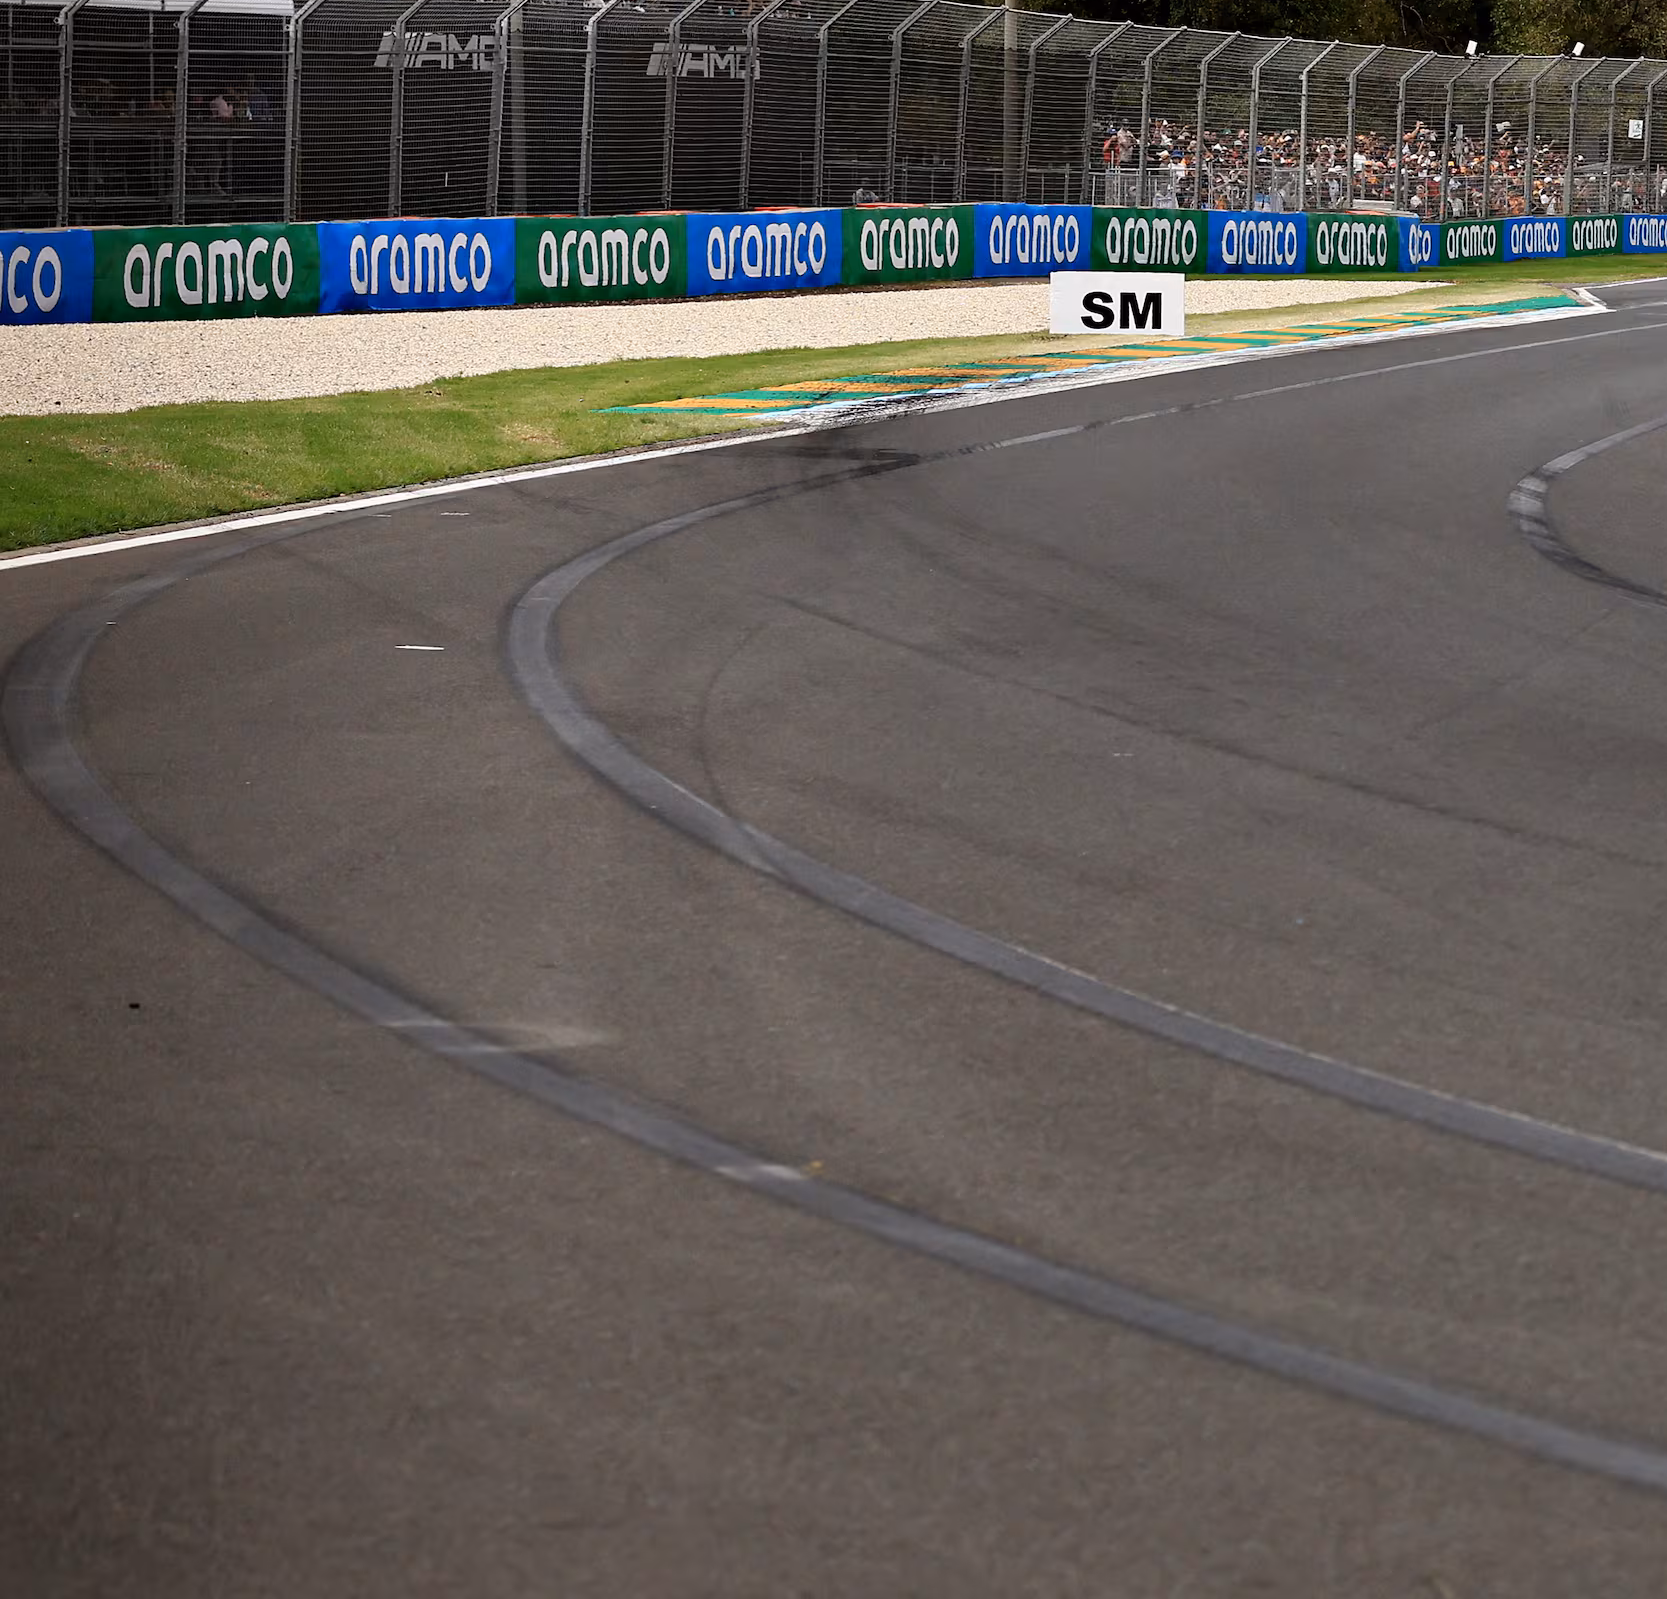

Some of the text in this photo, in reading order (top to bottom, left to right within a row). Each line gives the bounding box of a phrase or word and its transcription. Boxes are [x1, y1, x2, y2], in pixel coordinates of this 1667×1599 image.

[538, 227, 669, 288] aramco
[707, 221, 827, 281] aramco
[860, 217, 959, 271] aramco
[989, 214, 1080, 264] aramco
[1105, 216, 1198, 265] aramco
[1221, 219, 1297, 266] aramco
[1316, 221, 1388, 267] aramco
[1447, 224, 1496, 259] aramco
[1511, 221, 1560, 254] aramco
[1572, 218, 1618, 251] aramco
[124, 237, 294, 307] aramco
[350, 232, 492, 295] aramco
[1081, 293, 1162, 329] SM
